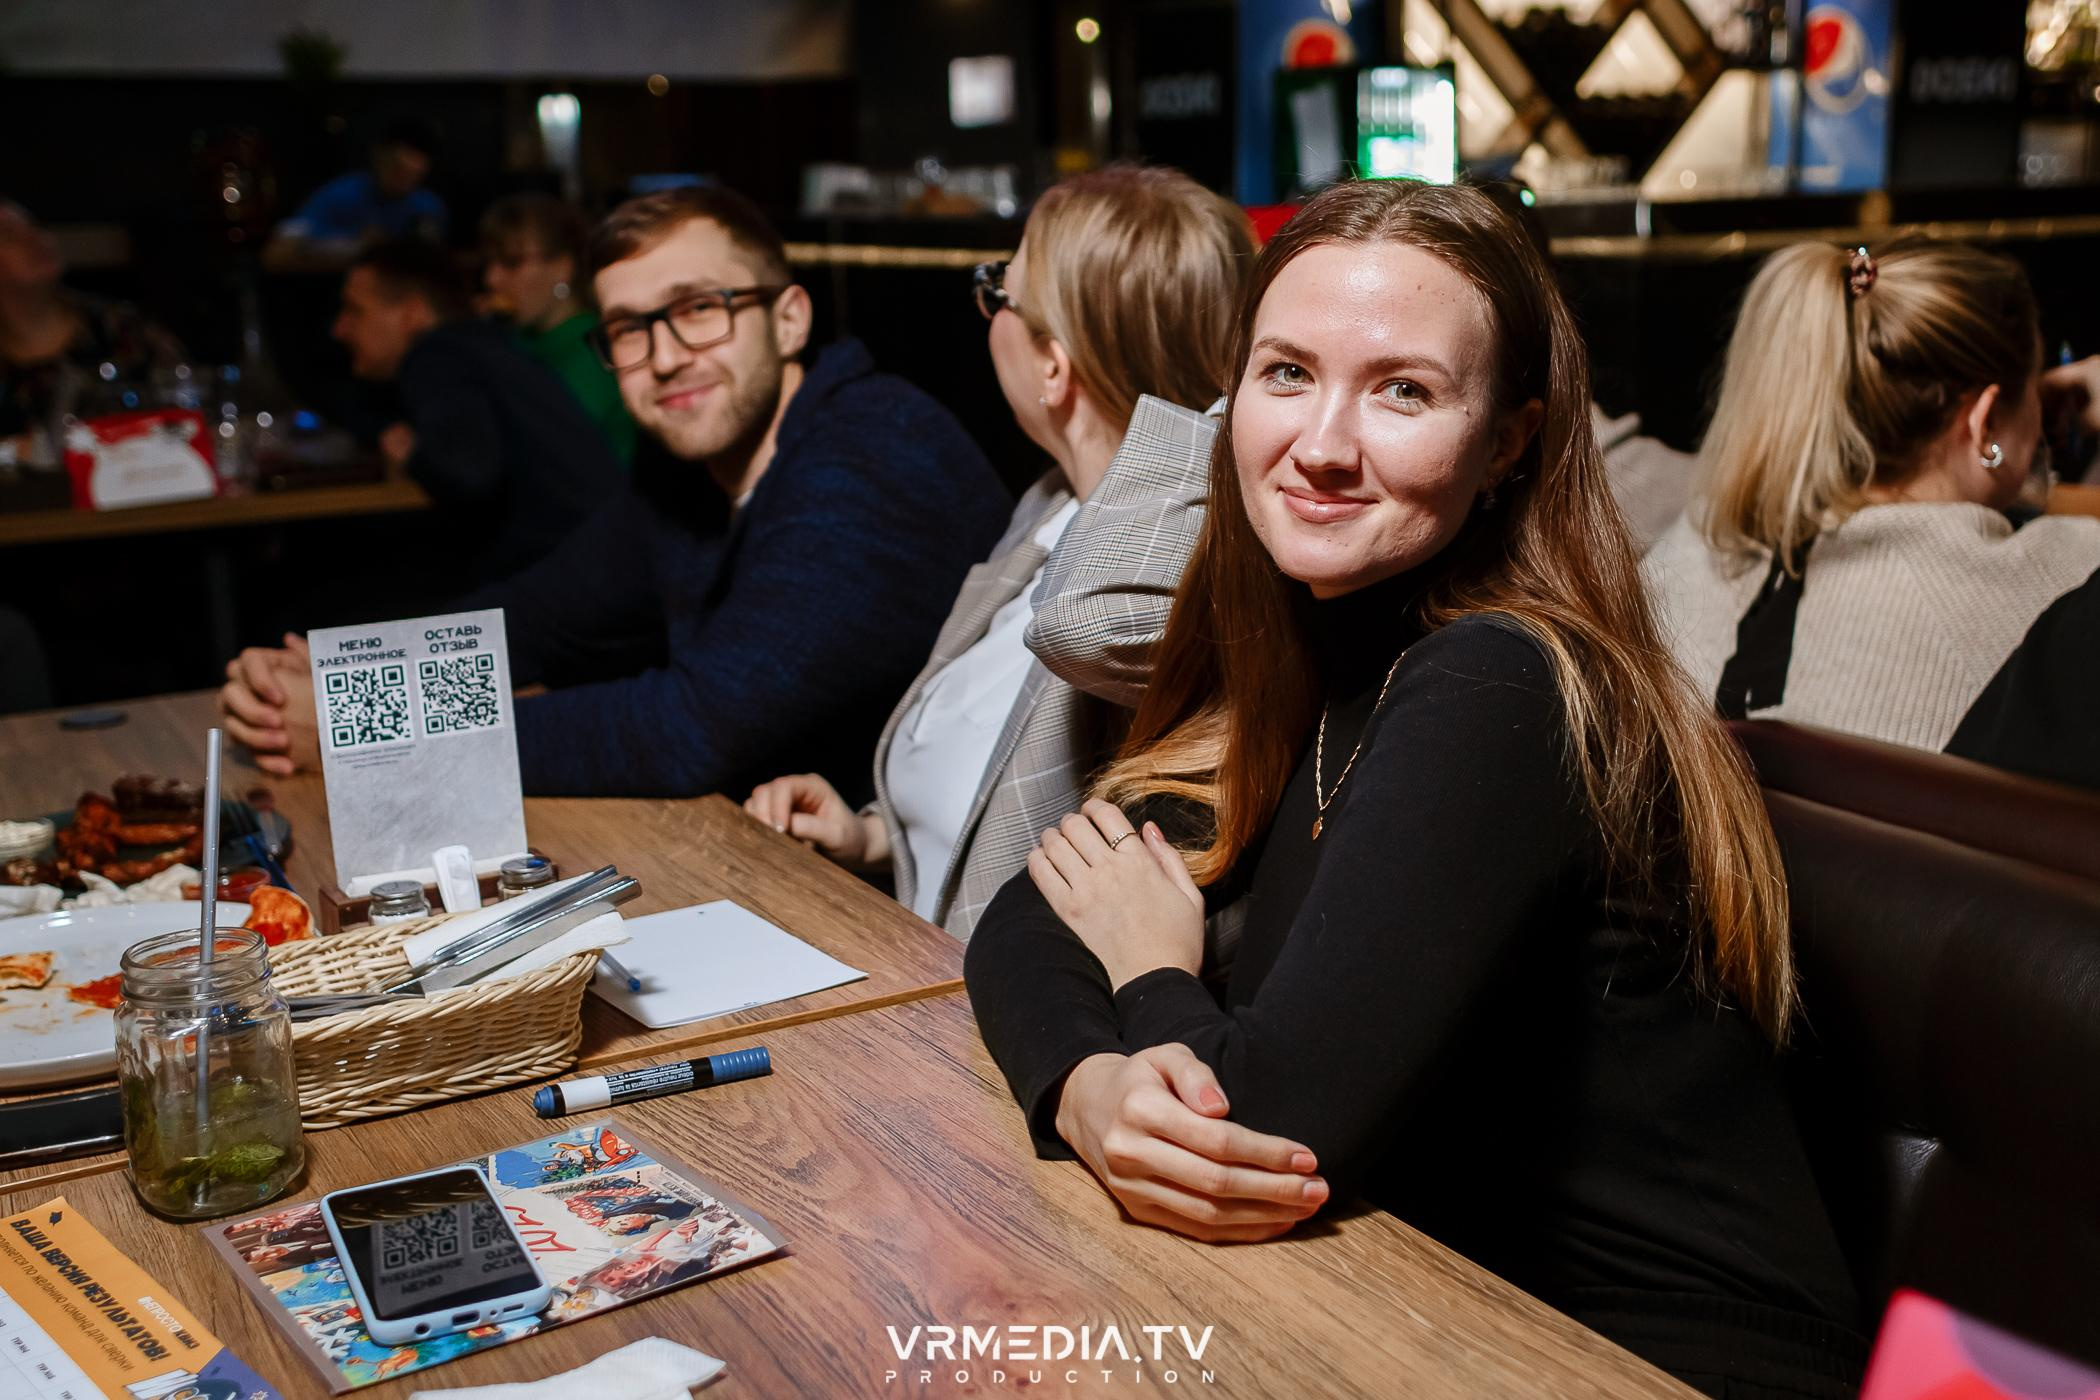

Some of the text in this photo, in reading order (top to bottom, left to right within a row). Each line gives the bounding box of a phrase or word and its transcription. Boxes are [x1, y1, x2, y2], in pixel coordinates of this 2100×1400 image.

[425, 625, 482, 641] ОСТАВЬ
[339, 637, 382, 651] МЕНЮ
[429, 638, 478, 654] ОТЗЫВ
[317, 649, 407, 667] ЭЛЕКТРОННОЕ
[10, 1218, 172, 1361] ВАША ВЕРСИЯ РЕЗУЛЬТАТОВ!
